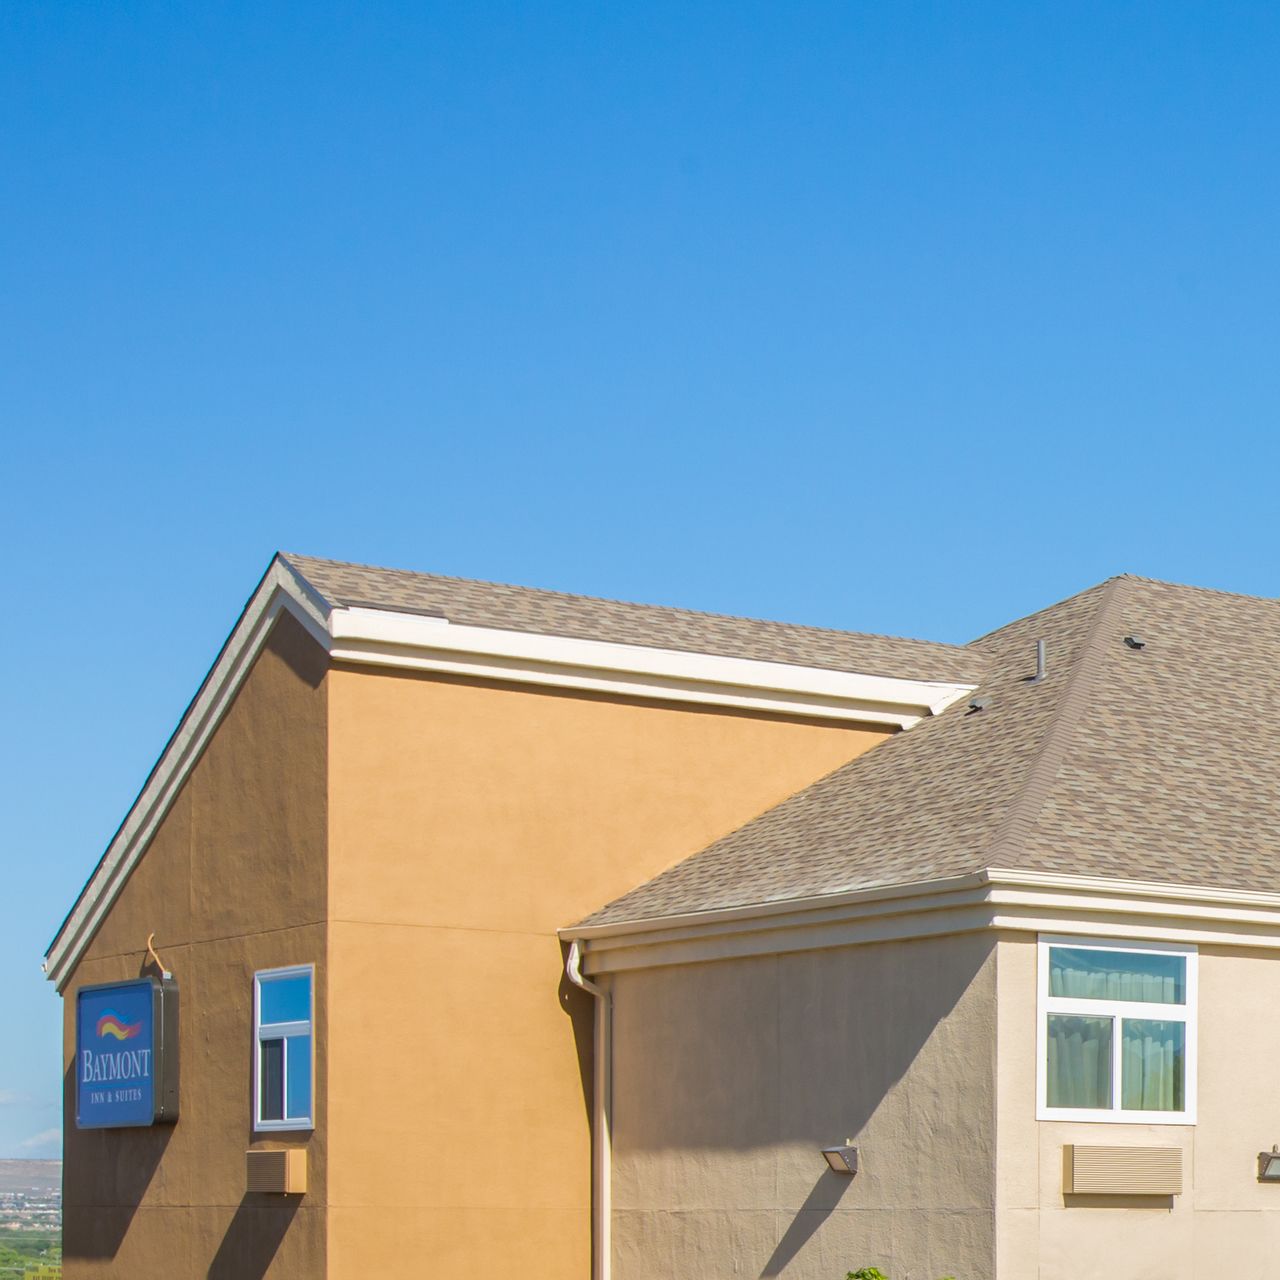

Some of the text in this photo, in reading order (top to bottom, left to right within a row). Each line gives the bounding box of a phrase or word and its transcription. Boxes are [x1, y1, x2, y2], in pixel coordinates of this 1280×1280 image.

[82, 1049, 151, 1082] BAYMONT
[91, 1088, 142, 1104] INN & SUITES
